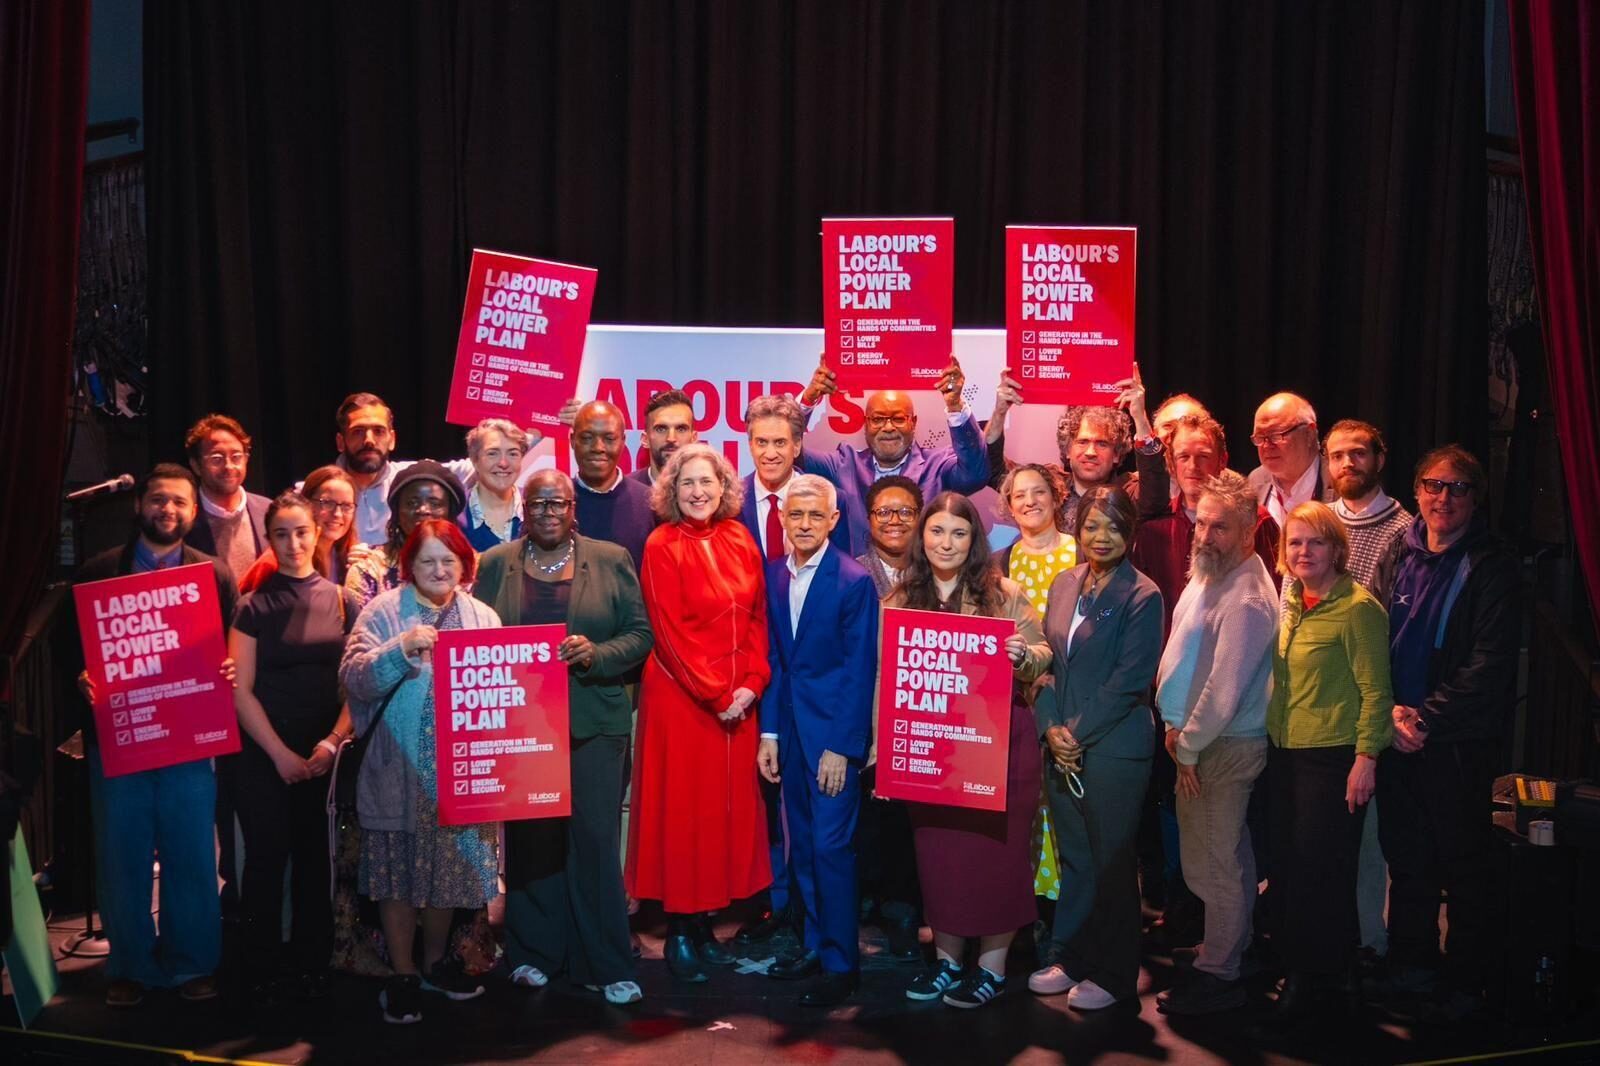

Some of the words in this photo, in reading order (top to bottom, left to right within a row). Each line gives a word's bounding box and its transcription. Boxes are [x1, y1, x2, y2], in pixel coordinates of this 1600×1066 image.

[840, 235, 937, 253] LABOUR'S
[1023, 244, 1120, 263] LABOUR'S
[840, 255, 903, 272] LOCAL
[840, 274, 910, 290] POWER
[1023, 264, 1085, 282] LOCAL
[485, 268, 579, 301] LABOUR'S
[1022, 283, 1093, 302] POWER
[482, 287, 544, 315] LOCAL
[840, 293, 891, 309] PLAN
[478, 307, 548, 334] POWER
[1023, 303, 1073, 321] PLAN
[476, 326, 526, 350] PLAN
[94, 583, 201, 619] LABOUR'S
[97, 610, 168, 641] LOCAL
[101, 630, 180, 662] POWER
[899, 627, 998, 656] LABOUR'S
[450, 643, 551, 667] LABOUR'S
[897, 648, 962, 673] LOCAL
[105, 654, 162, 683] PLAN
[451, 666, 517, 689] LOCAL
[896, 669, 969, 695] POWER
[451, 687, 525, 710] POWER
[895, 690, 947, 713] PLAN
[452, 709, 505, 732] PLAN
[911, 722, 954, 733] GENERATION
[963, 727, 976, 735] THE
[471, 740, 514, 749] GENERATION
[910, 740, 934, 749] LOWER
[911, 729, 933, 737] HANDS
[944, 733, 992, 744] COMMUNITIES
[505, 744, 553, 754] COMMUNITIES
[910, 747, 929, 755] BILLS
[471, 760, 495, 768] LOWER
[471, 767, 491, 775] BILLS
[909, 766, 942, 775] SECURITY
[910, 759, 935, 768] ENERGY
[472, 779, 498, 787] ENERGY
[472, 785, 505, 794] SECURITY
